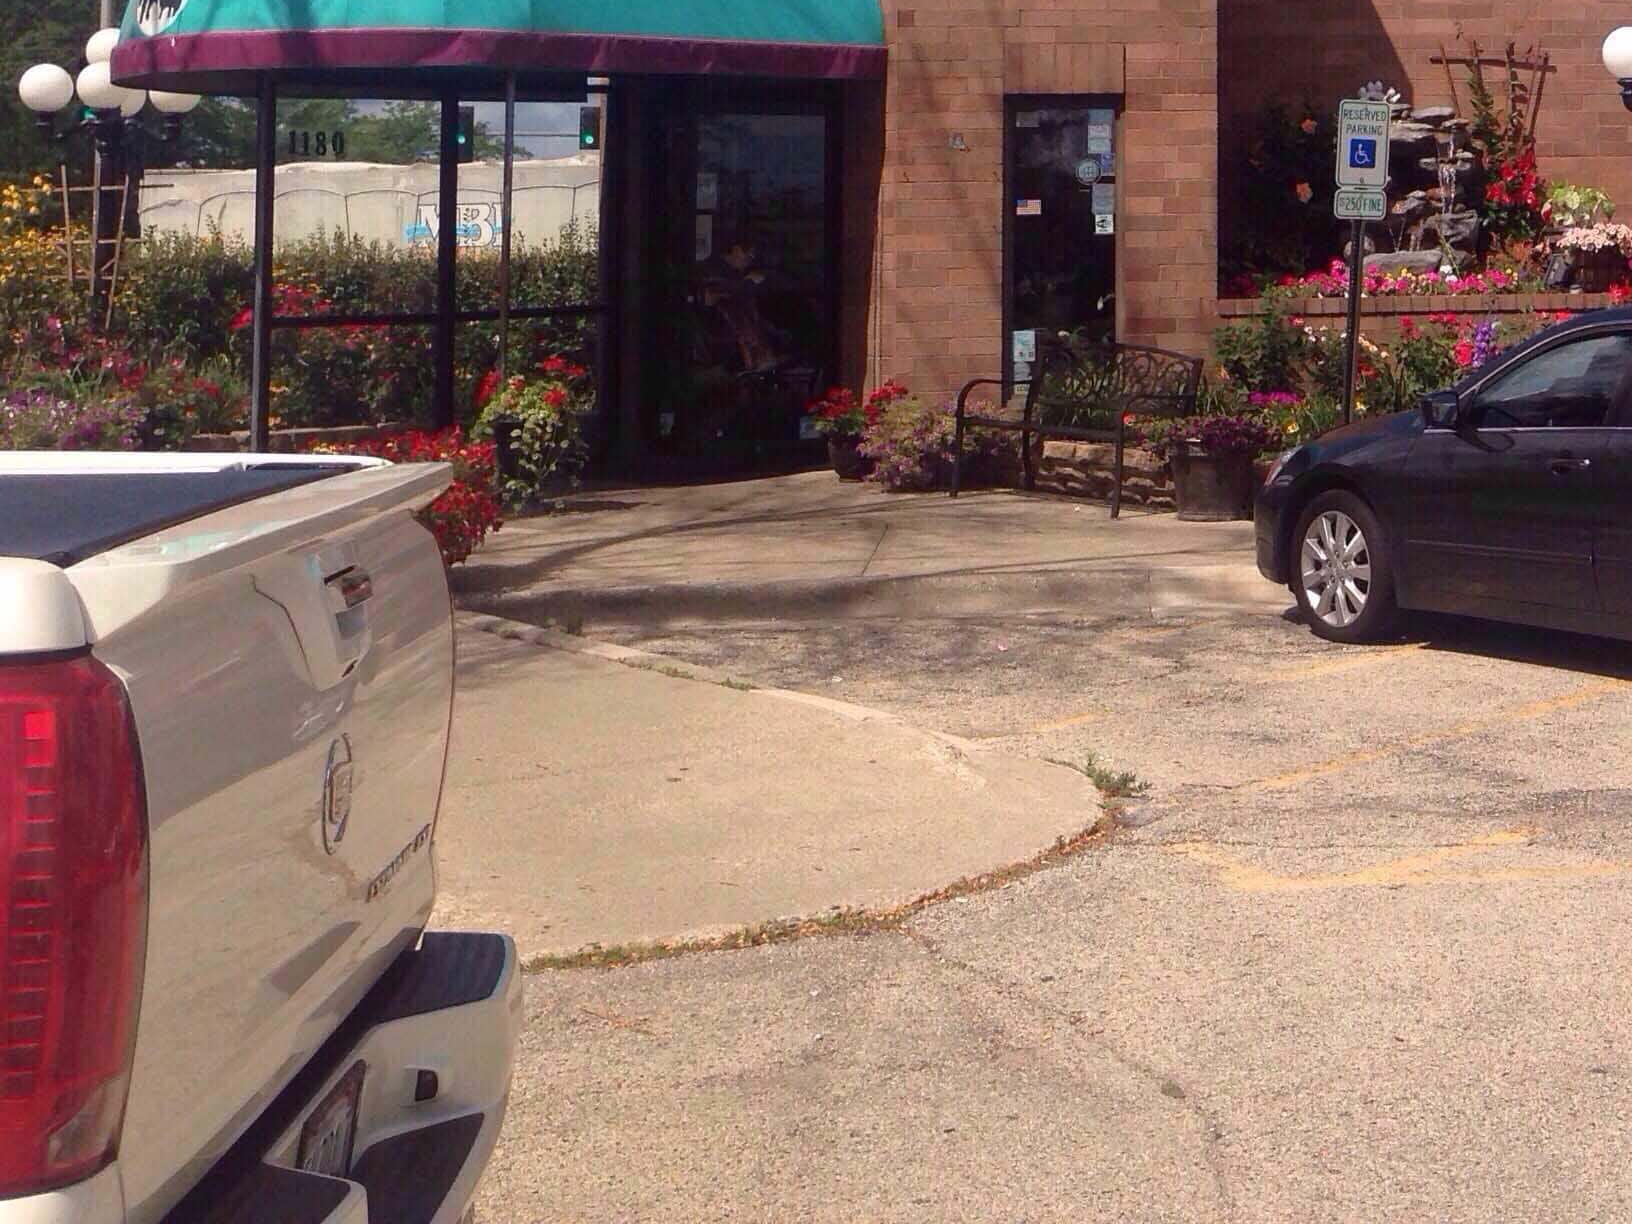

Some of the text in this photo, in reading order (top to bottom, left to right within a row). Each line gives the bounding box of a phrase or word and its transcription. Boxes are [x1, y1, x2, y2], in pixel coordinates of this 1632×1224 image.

[1342, 108, 1387, 123] RESERVED
[1344, 123, 1384, 137] PARKING
[1362, 197, 1383, 212] FINE
